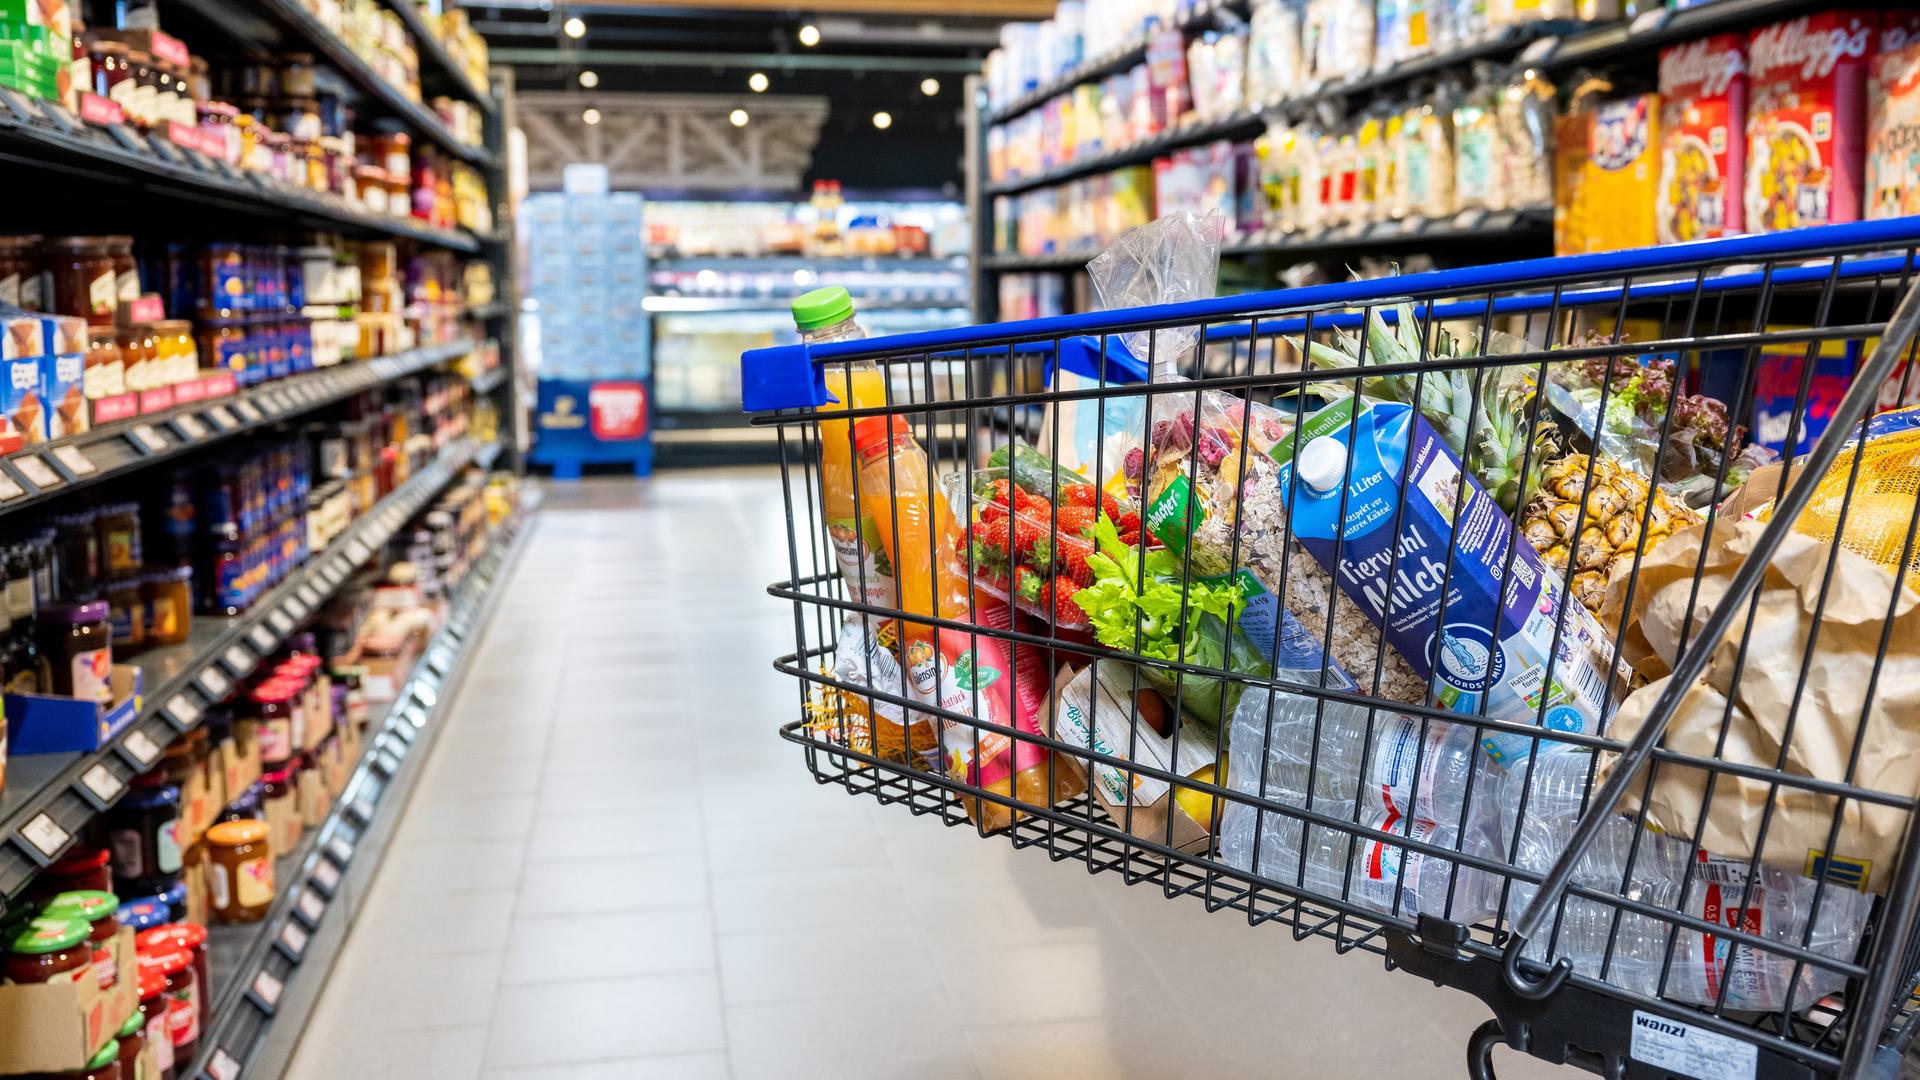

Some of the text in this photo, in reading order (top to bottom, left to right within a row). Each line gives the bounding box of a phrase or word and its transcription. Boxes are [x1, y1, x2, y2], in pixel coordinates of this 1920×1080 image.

[1748, 16, 1871, 80] Kellogg's
[1349, 472, 1382, 498] 1 Liter
[1147, 488, 1179, 532] nbacher
[1371, 497, 1383, 509] vor
[1340, 524, 1427, 585] Tierwohl
[1363, 556, 1454, 618] Milch
[1254, 597, 1269, 607] 419
[911, 664, 942, 686] alensin
[1447, 650, 1505, 690] NORDSE MILCH
[1510, 666, 1542, 688] Haltungs-
[1522, 676, 1540, 689] form
[1406, 824, 1426, 865] MINAL
[1706, 904, 1717, 919] 0,5
[1636, 1016, 1686, 1038] wanzl
